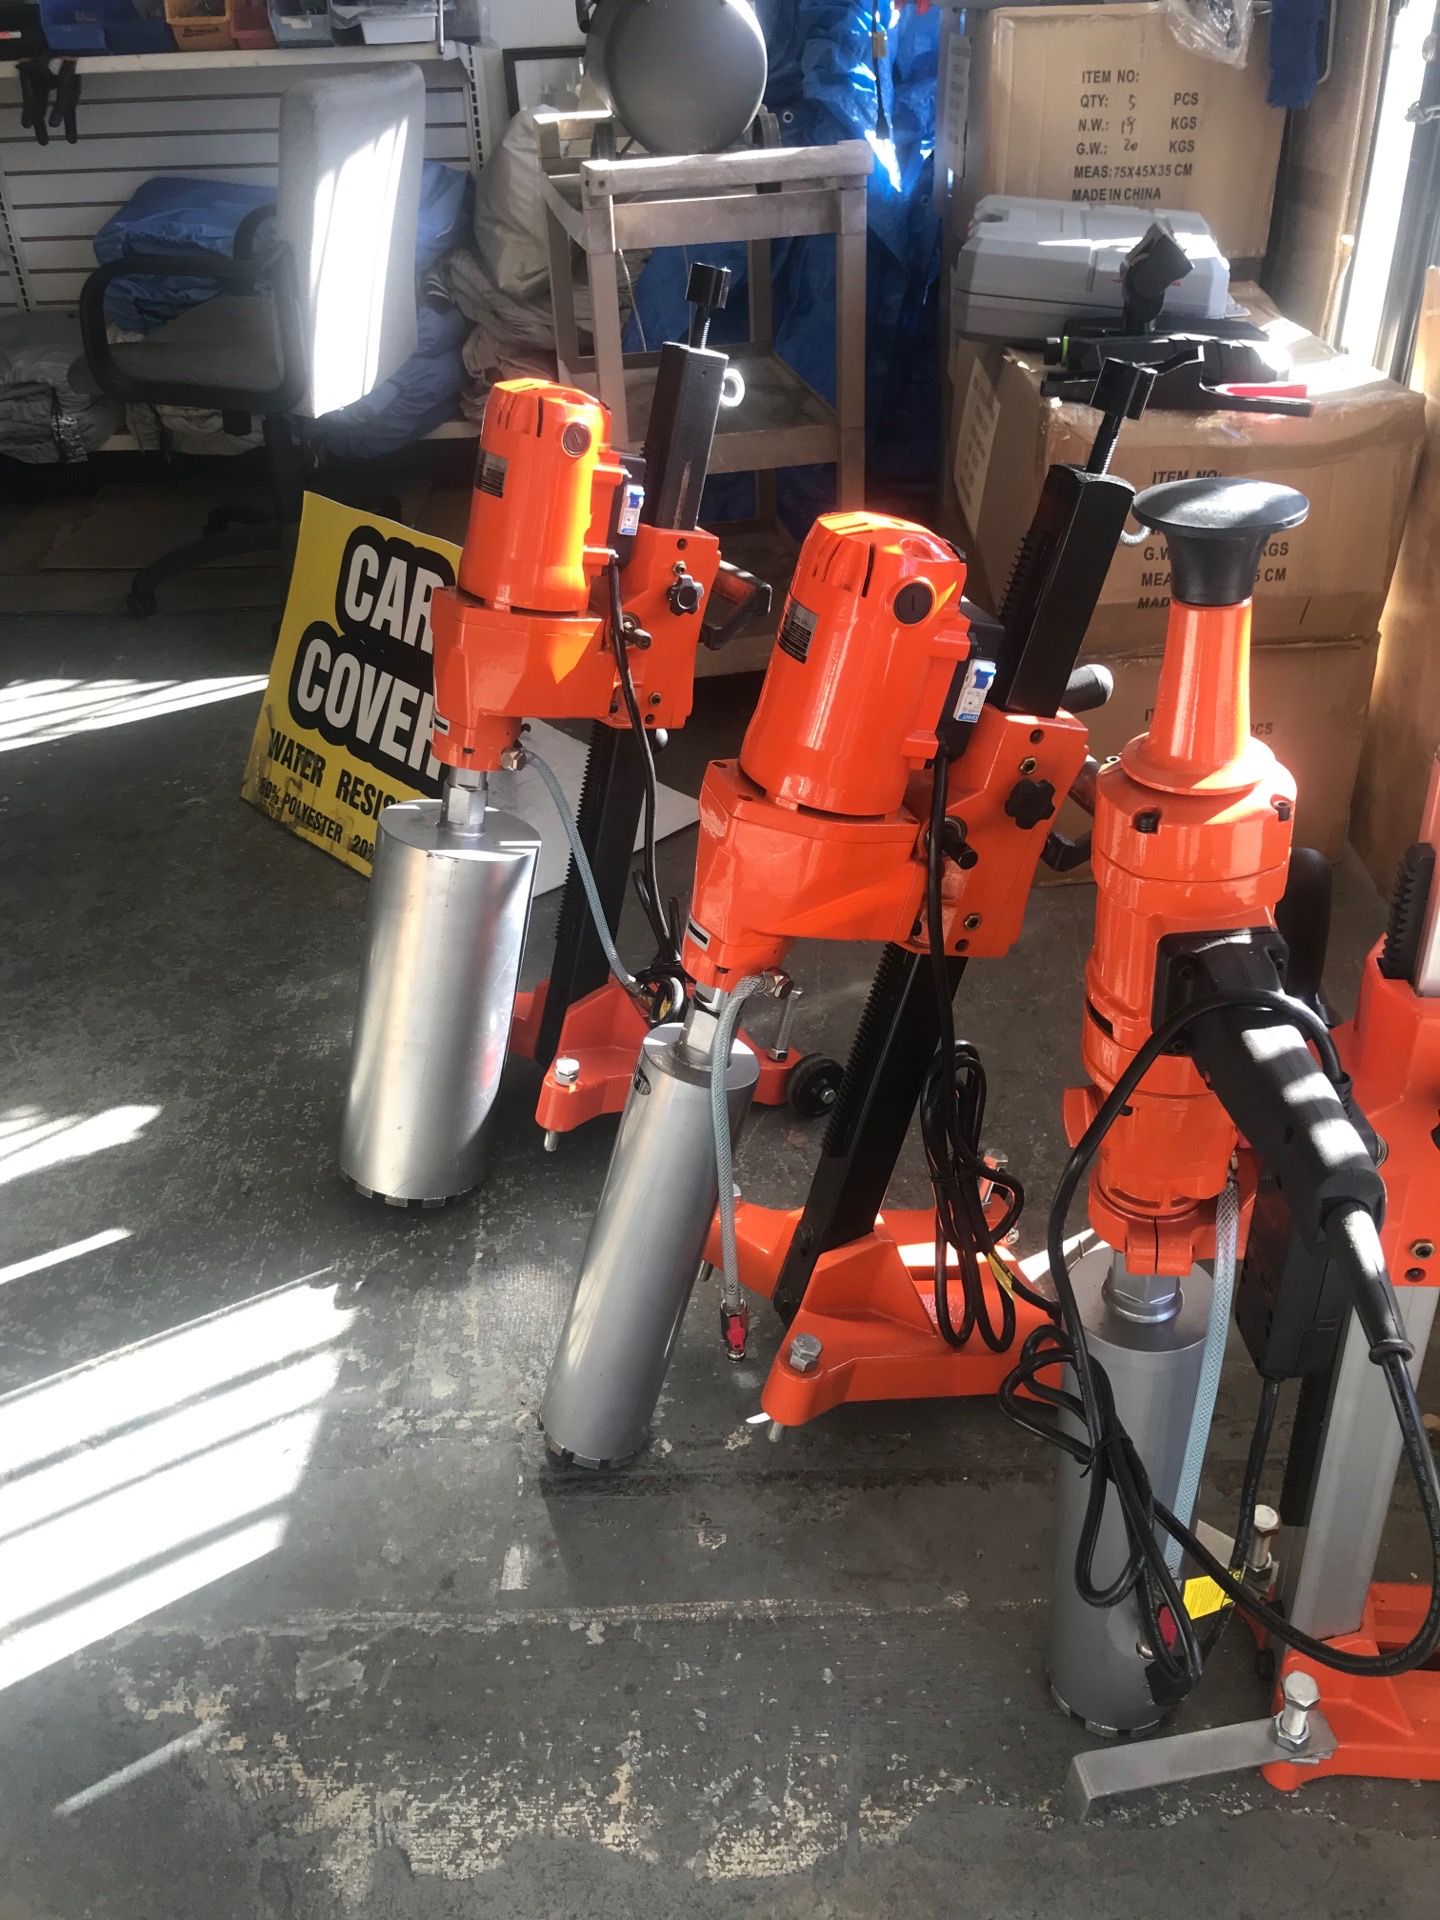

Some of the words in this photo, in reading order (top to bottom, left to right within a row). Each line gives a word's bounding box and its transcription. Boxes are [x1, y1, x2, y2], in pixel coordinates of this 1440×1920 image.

[1082, 70, 1111, 83] ITEM
[1117, 70, 1140, 83] NO:
[1080, 94, 1108, 108] QTY:
[1128, 94, 1136, 111] 5
[1173, 92, 1199, 106] PCS
[1078, 118, 1109, 131] N.W.:
[1170, 116, 1197, 130] KGS
[1076, 142, 1107, 155] G.W.:
[1124, 138, 1138, 151] 20
[1169, 140, 1195, 153] KGS
[1174, 163, 1193, 176] CM
[1072, 188, 1107, 201] MADE
[1109, 188, 1121, 200] IN
[1124, 187, 1161, 200] CHINA
[1263, 542, 1289, 557] GS
[1264, 567, 1287, 582] CM
[344, 544, 445, 655] CAR
[297, 638, 442, 781] COVER
[268, 728, 327, 788] WATER
[283, 792, 343, 844] POLYESTER
